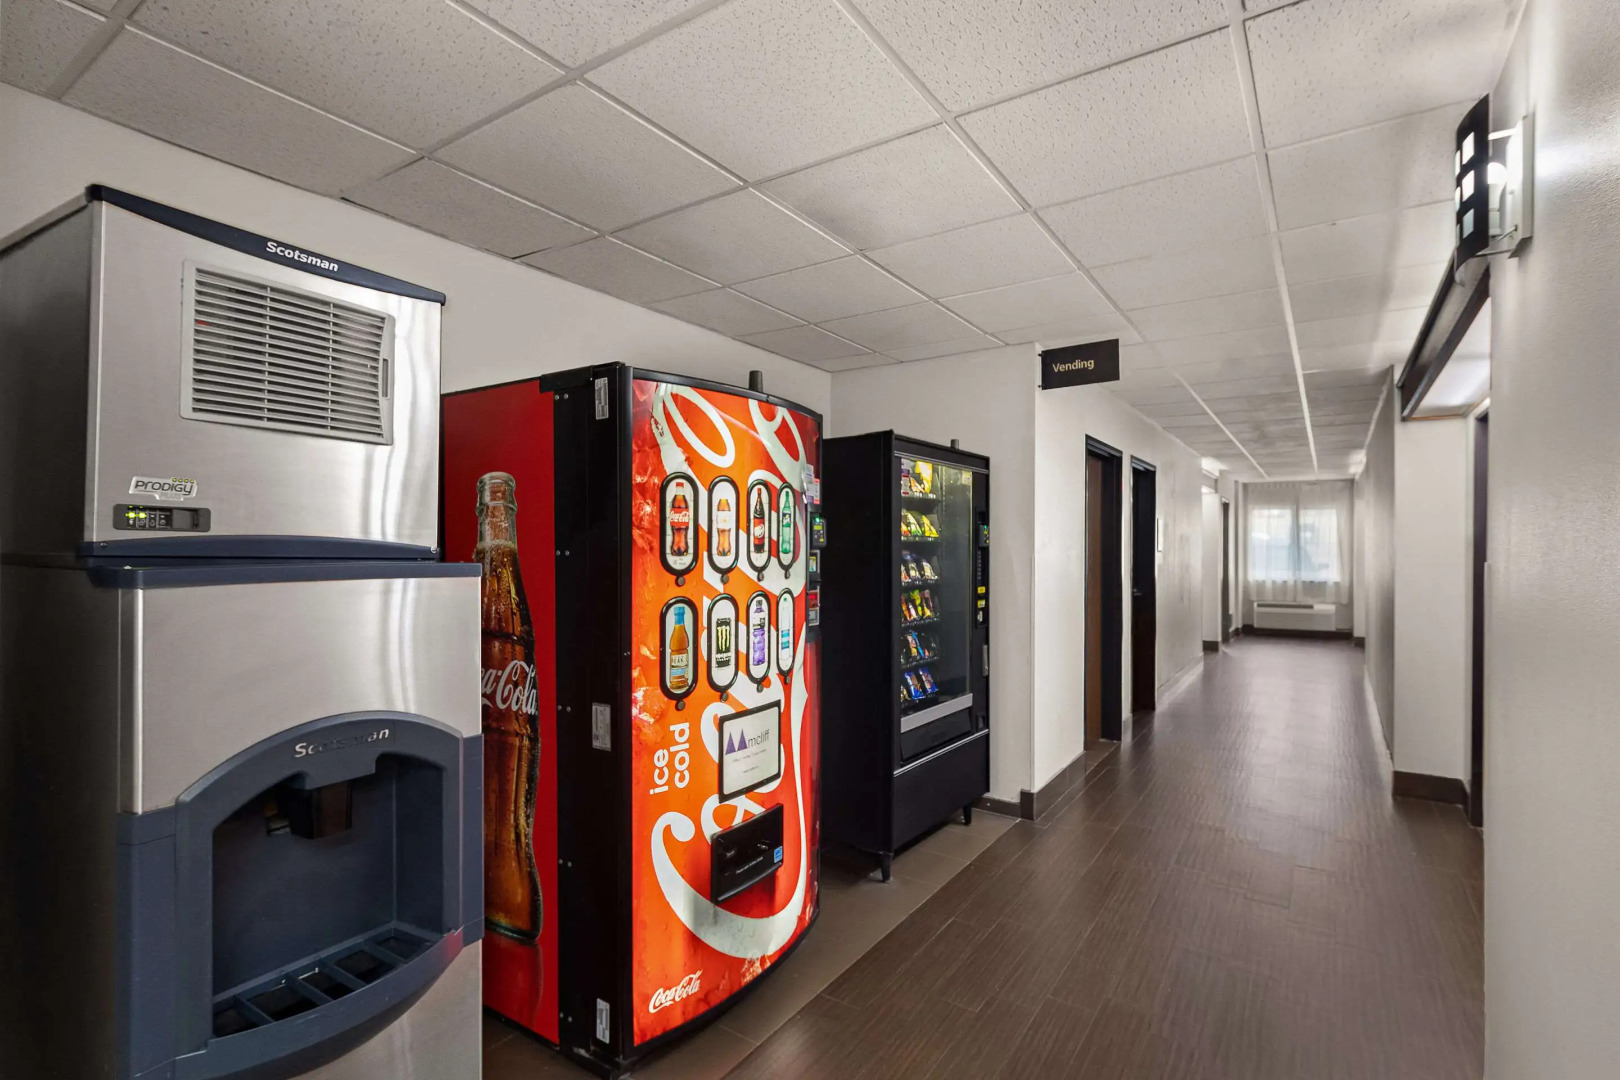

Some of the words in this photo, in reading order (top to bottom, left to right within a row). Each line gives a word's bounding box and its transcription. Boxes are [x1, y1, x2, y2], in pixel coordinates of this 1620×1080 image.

[265, 241, 339, 272] Scotsman
[1052, 359, 1095, 373] Vending
[669, 722, 690, 789] cold
[747, 729, 770, 749] mcliff
[649, 749, 669, 795] ice
[648, 969, 703, 1013] Coca-Cola
